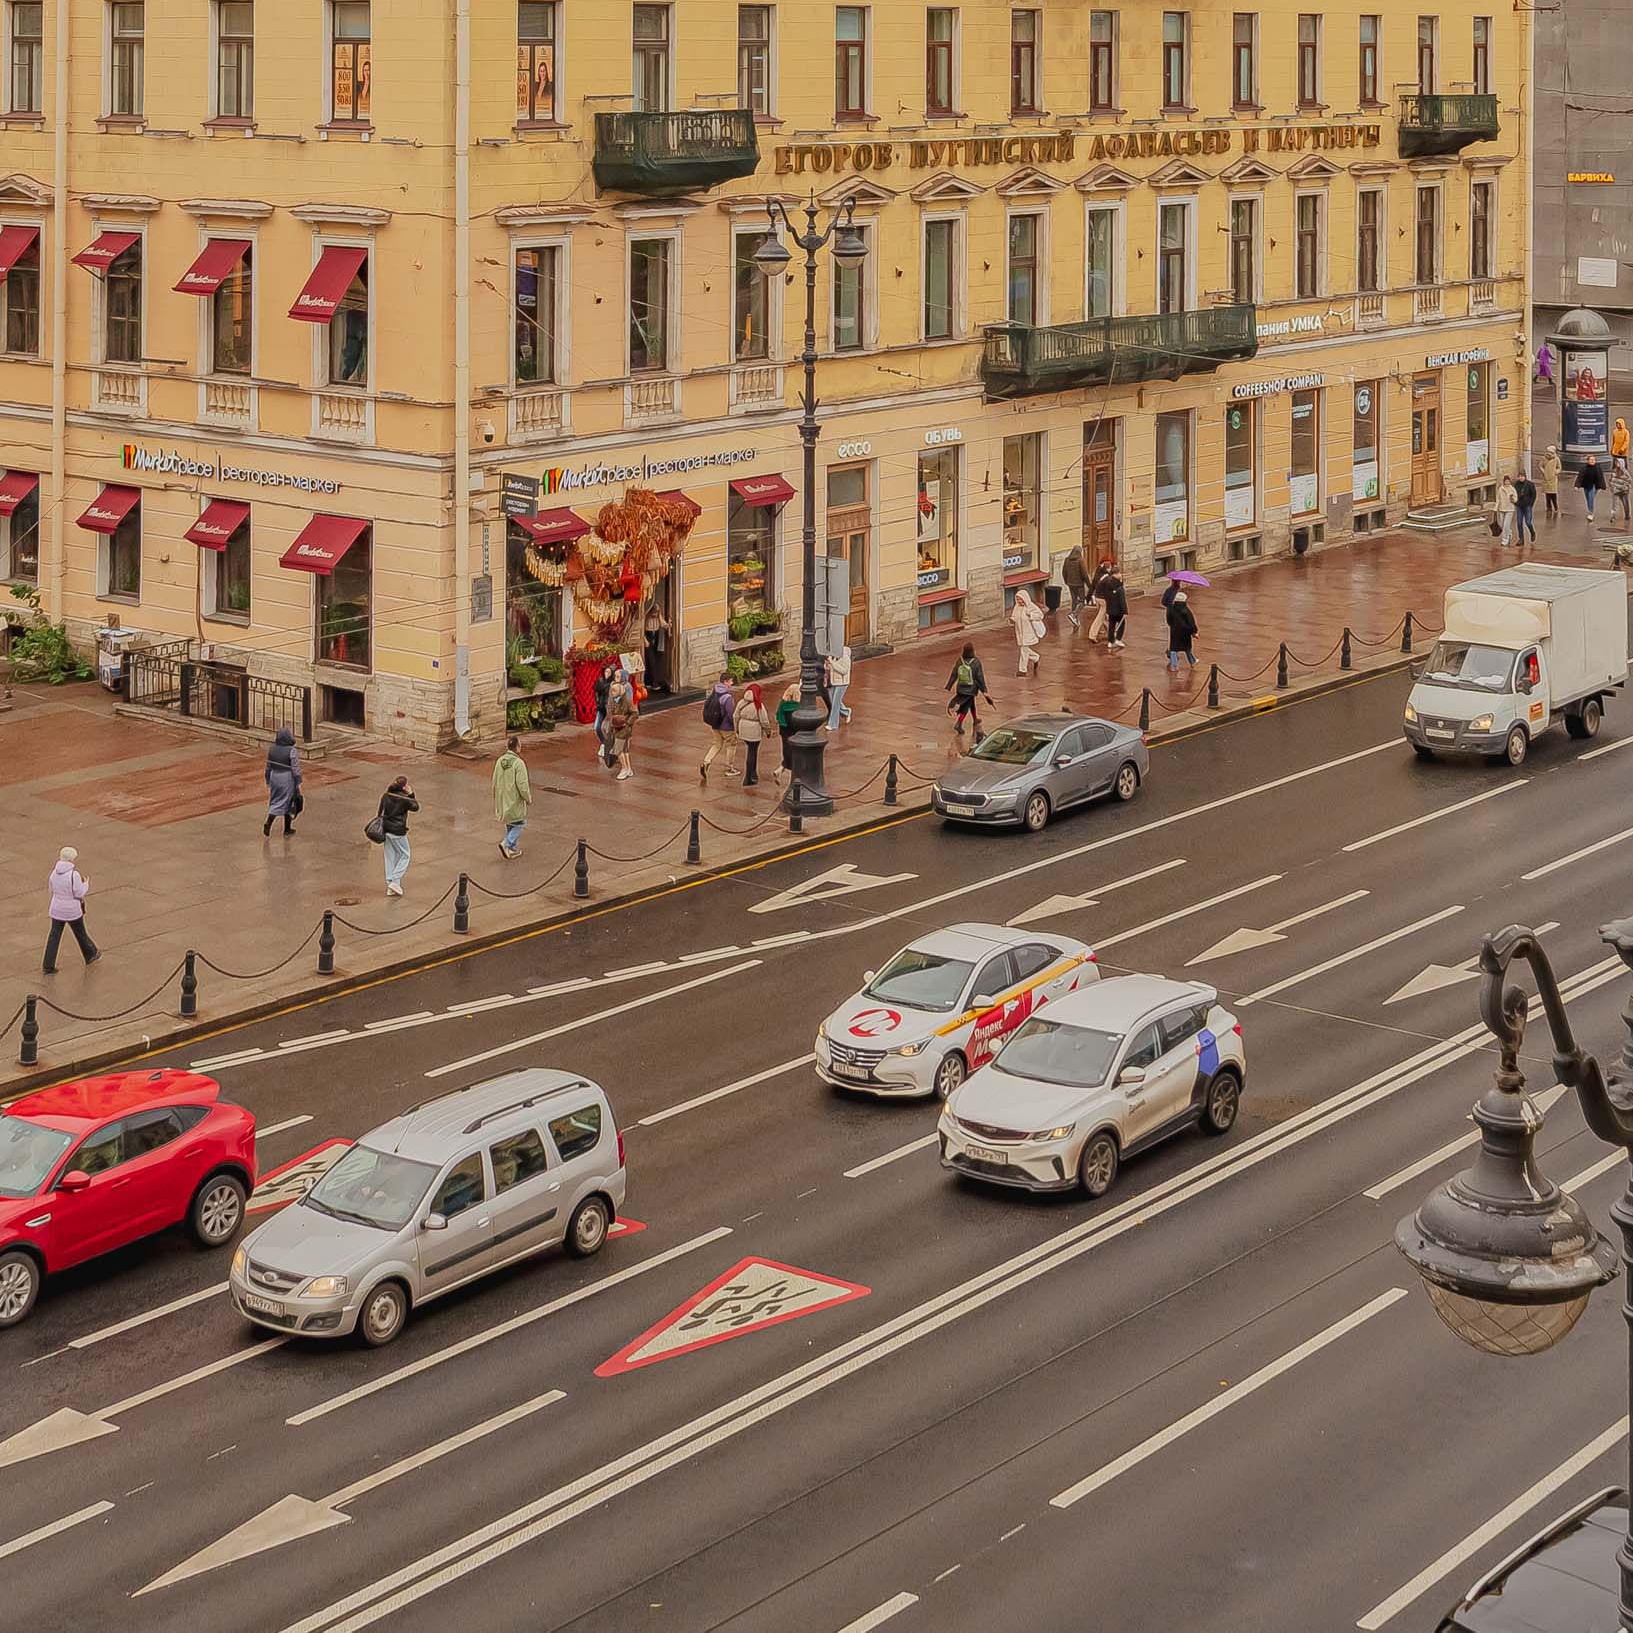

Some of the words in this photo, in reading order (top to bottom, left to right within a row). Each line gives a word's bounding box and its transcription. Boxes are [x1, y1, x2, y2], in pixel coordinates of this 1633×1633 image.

[338, 71, 351, 81] 800
[775, 143, 893, 175] ЕГОРОВ
[1088, 129, 1231, 160] АФАНАСЬЕВ
[1243, 128, 1260, 153] И
[1269, 124, 1381, 152] ПАРТНЕРЫ
[1568, 173, 1615, 182] БАРВИХА
[1256, 319, 1289, 336] пания
[1290, 316, 1323, 332] УМКА
[1427, 354, 1459, 367] ВЕНСКАЯ
[1235, 378, 1286, 397] COFFEESHOP
[1287, 373, 1325, 390] COMPANY
[925, 427, 962, 444] ОБУВЬ
[838, 441, 872, 458] ecco
[648, 448, 757, 479] ресторан-маркет
[222, 467, 343, 494] ресторан-маркет
[974, 1019, 1003, 1041] Яндекс
